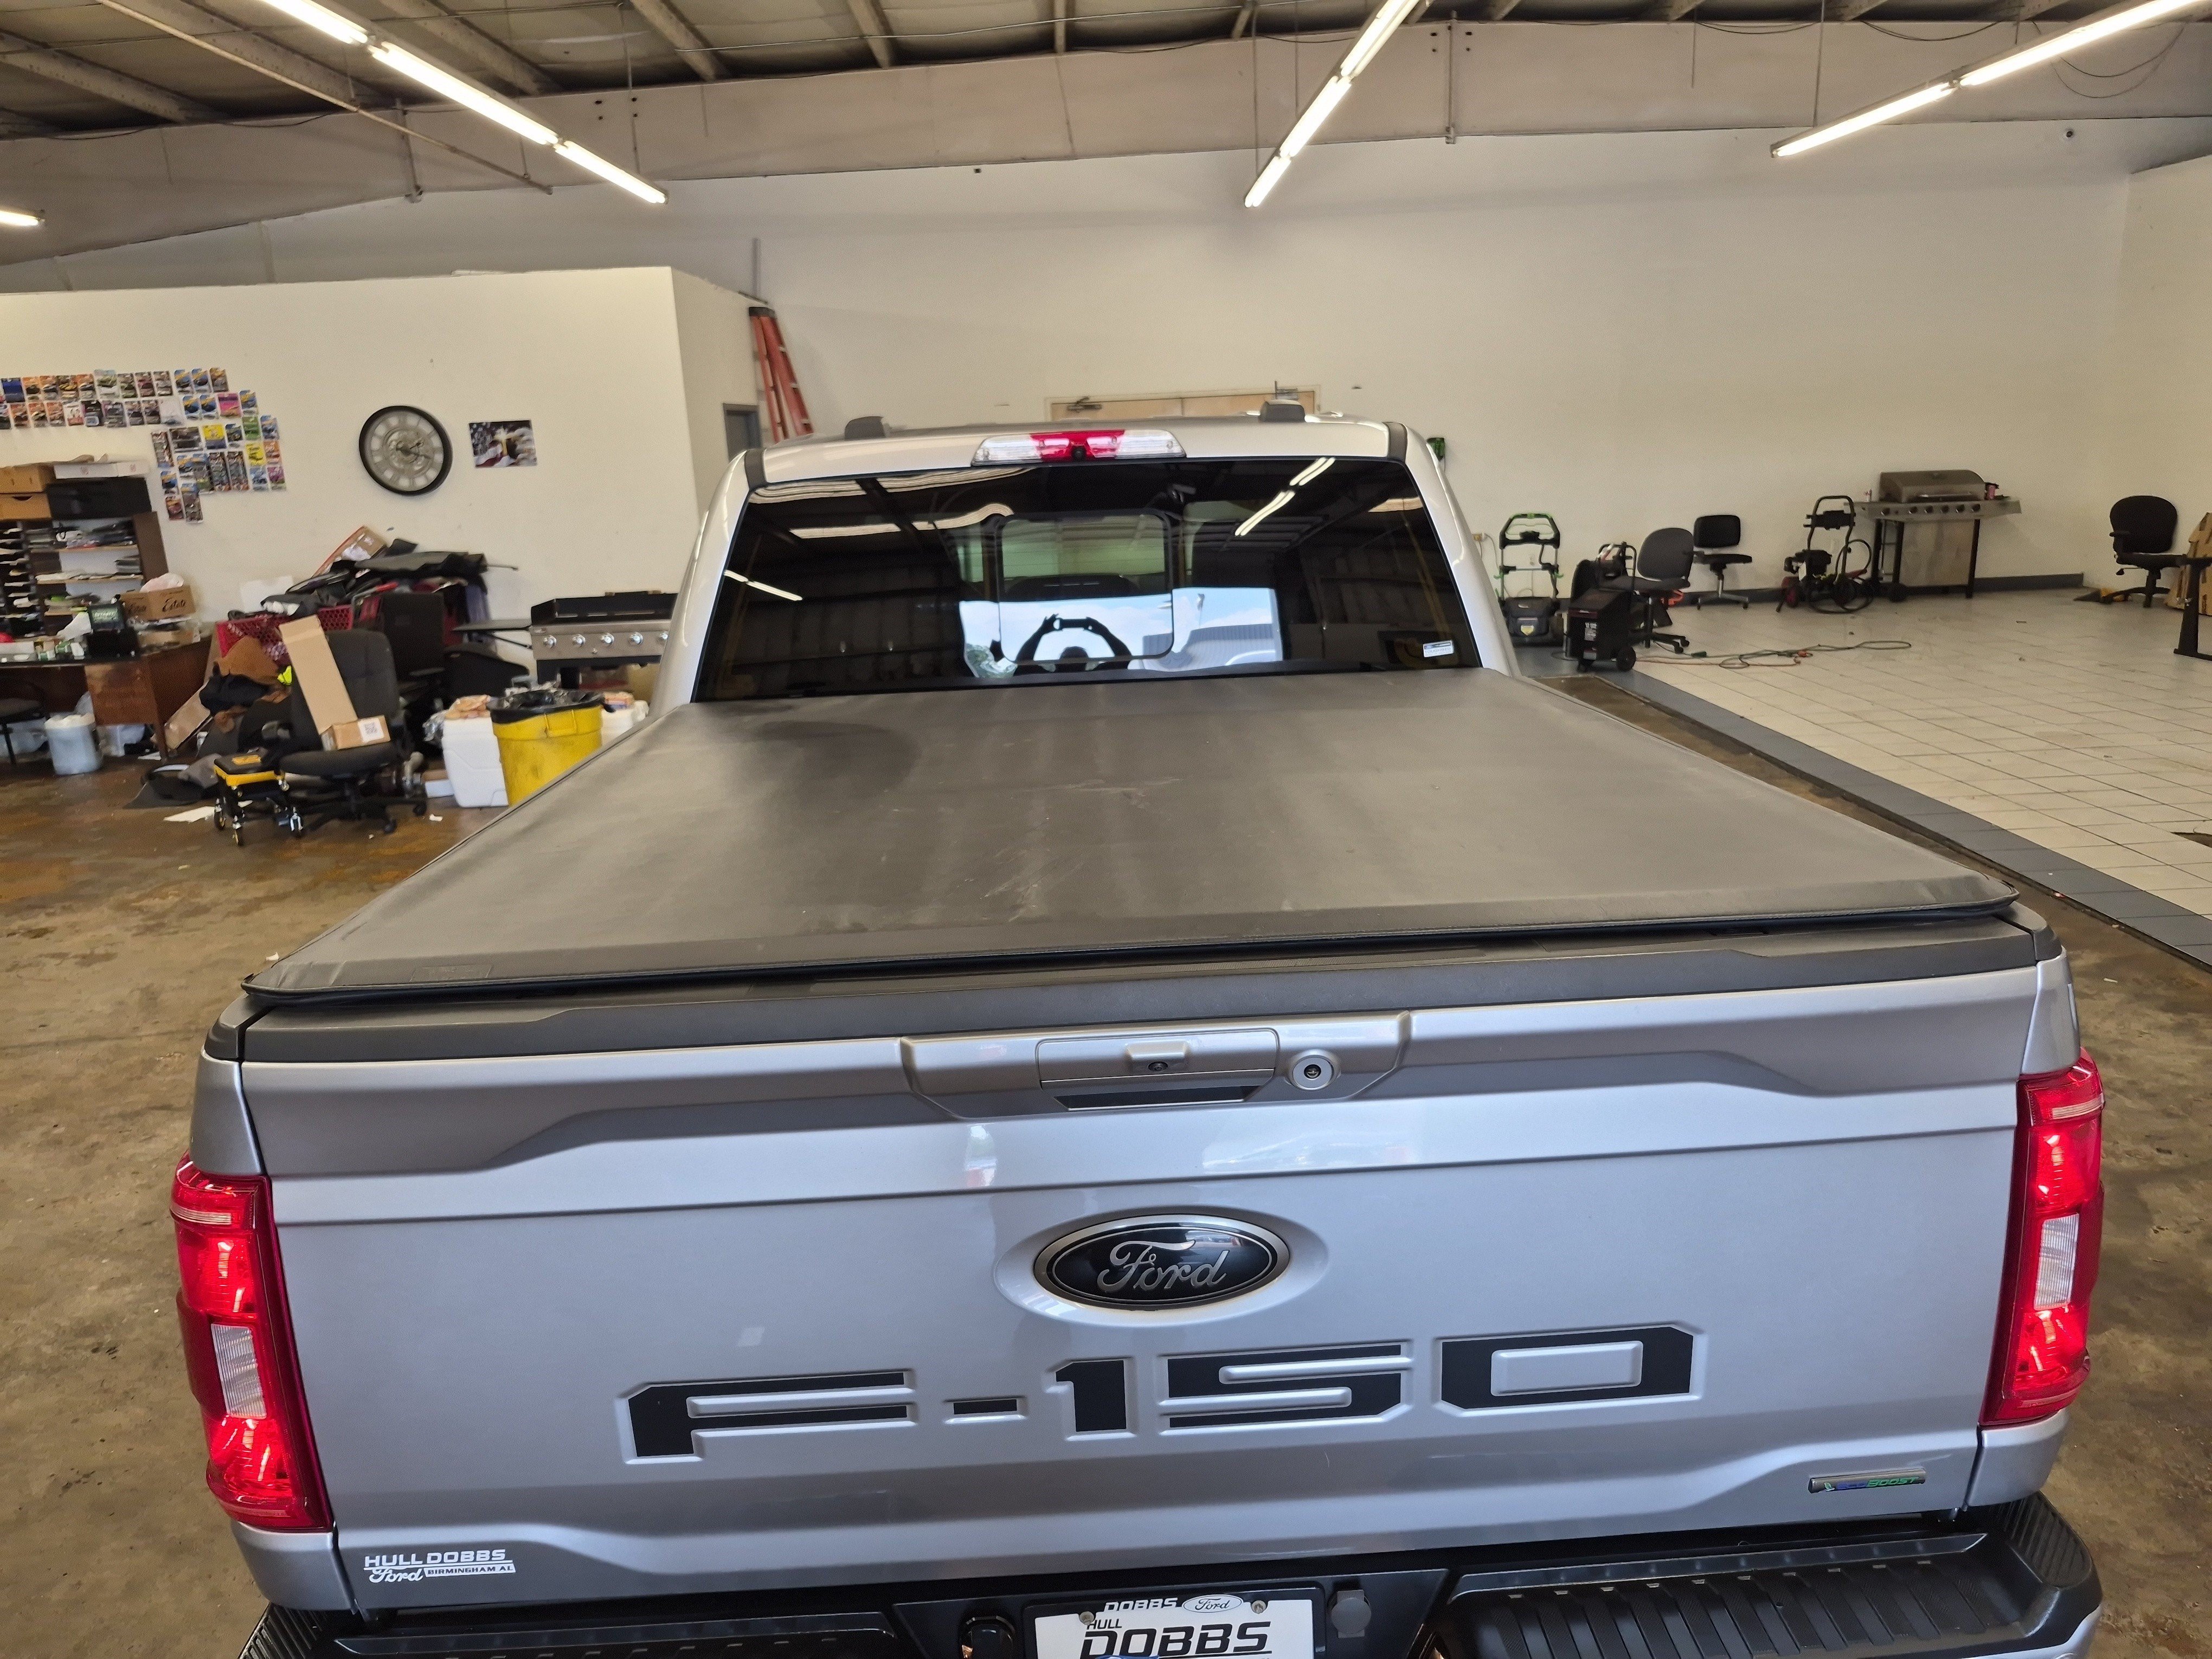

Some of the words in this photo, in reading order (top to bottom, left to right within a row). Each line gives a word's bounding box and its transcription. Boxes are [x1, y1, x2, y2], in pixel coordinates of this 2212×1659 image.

[1097, 1239, 1229, 1293] Ford
[622, 1323, 1701, 1461] F-150
[365, 1553, 423, 1567] HULL
[427, 1549, 506, 1564] DOBBS
[369, 1566, 423, 1583] Ford
[427, 1566, 496, 1575] BIRMINGHAM
[1103, 1597, 1178, 1612] DOBBS
[1194, 1598, 1231, 1610] Ford
[1086, 1618, 1122, 1630] HULL
[1080, 1621, 1271, 1659] DOBBS
